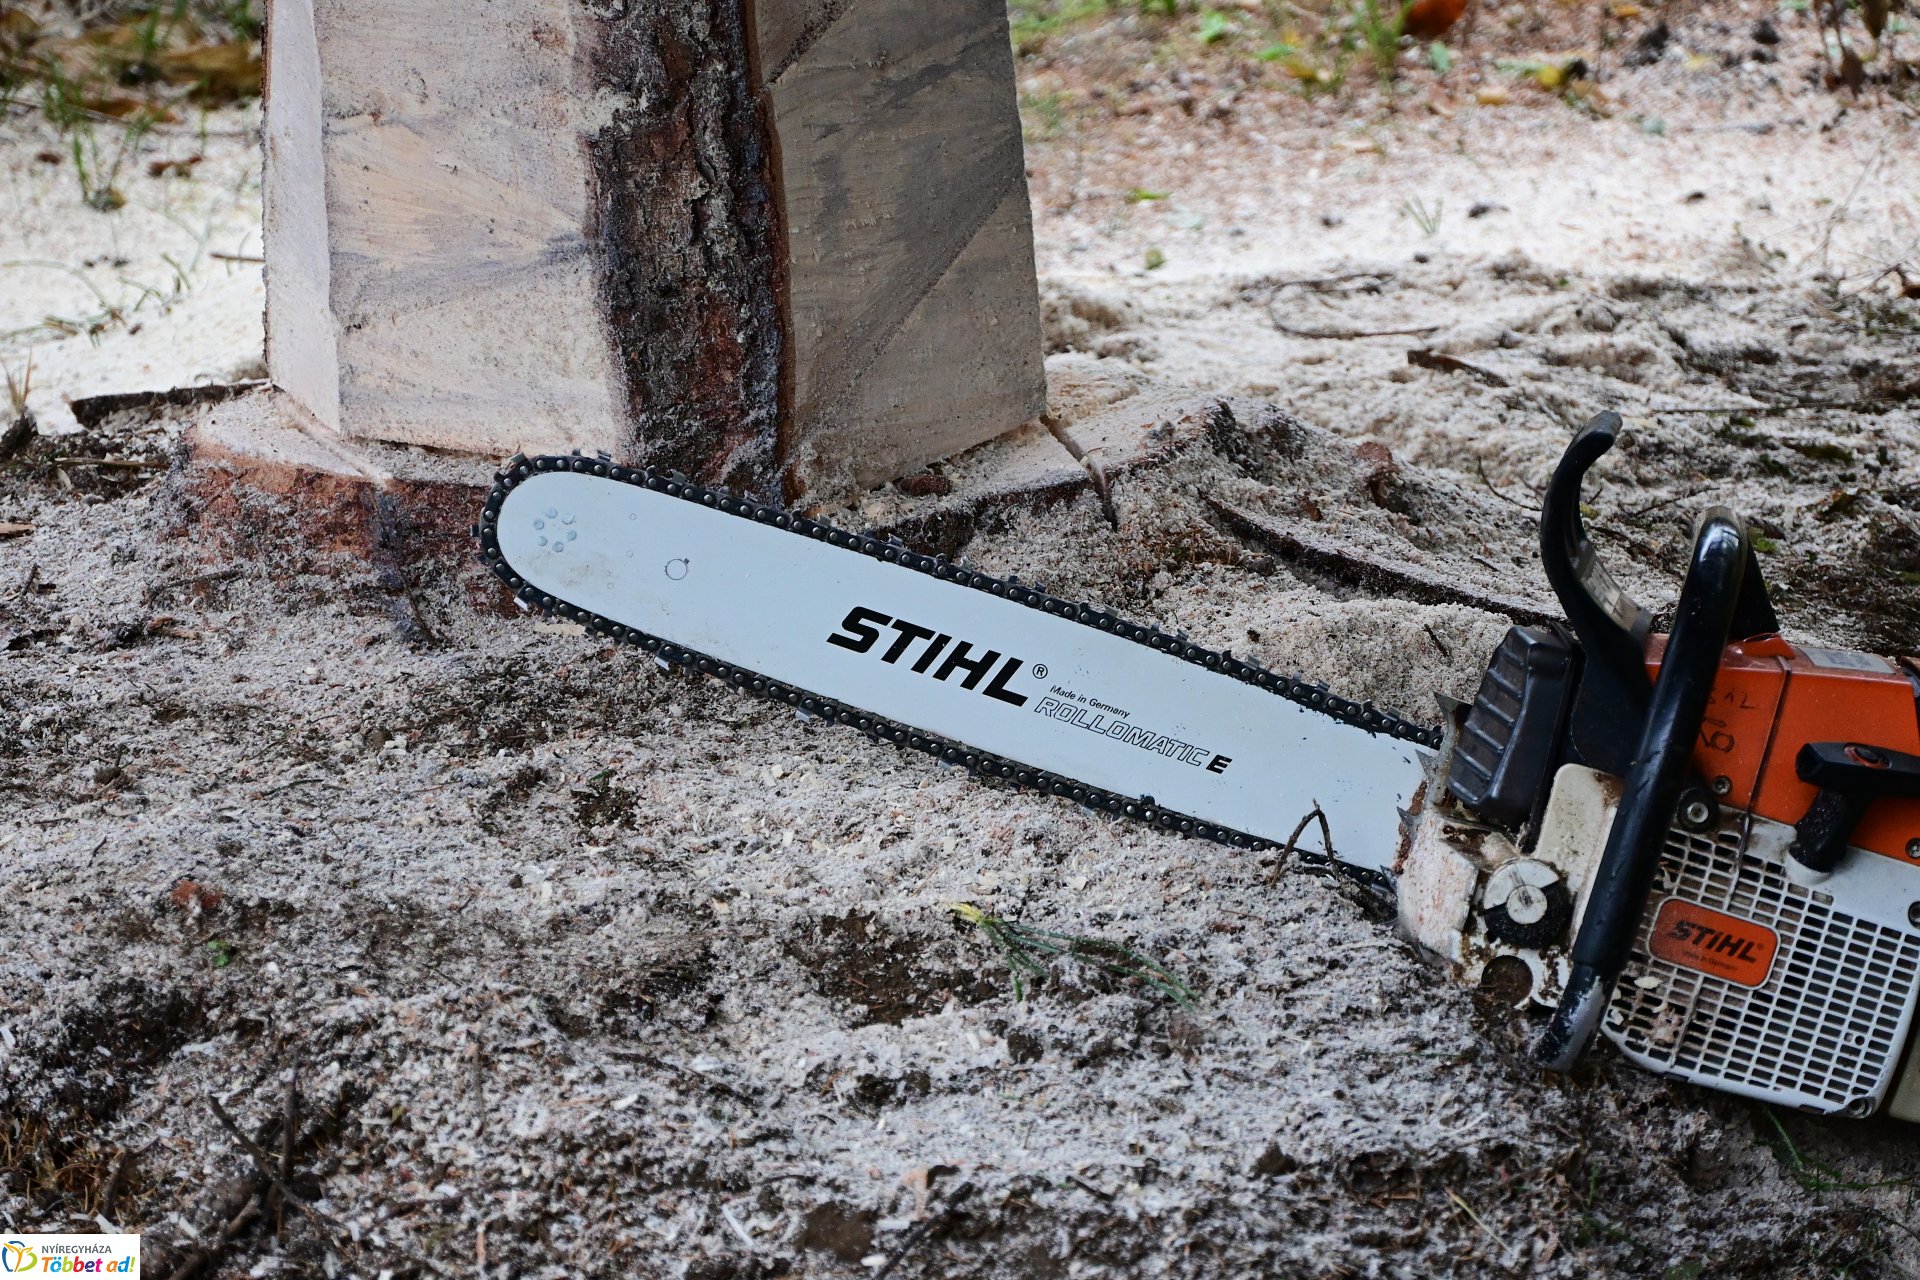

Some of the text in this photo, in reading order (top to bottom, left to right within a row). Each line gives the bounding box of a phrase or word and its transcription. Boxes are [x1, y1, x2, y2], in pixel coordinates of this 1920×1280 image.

[826, 606, 1029, 707] STIHL
[1050, 685, 1130, 719] Made in Germany
[1034, 696, 1233, 774] ROLLOMATIC E
[1669, 920, 1757, 964] STIHL
